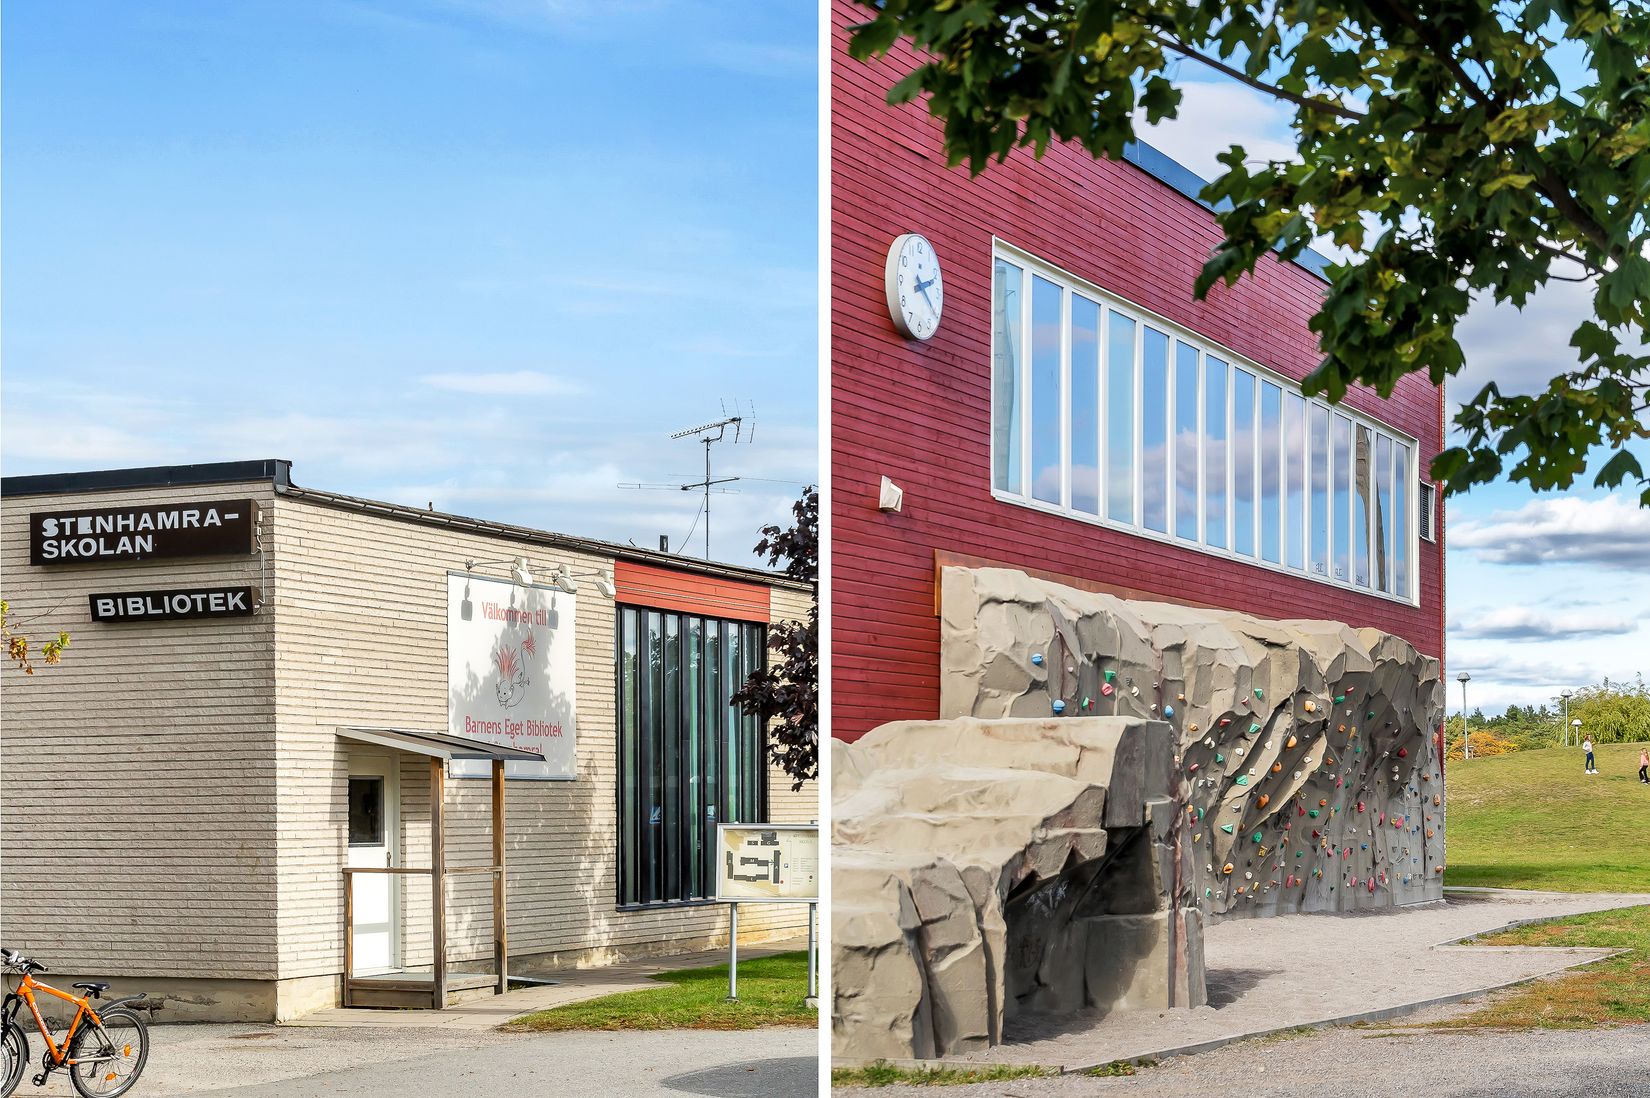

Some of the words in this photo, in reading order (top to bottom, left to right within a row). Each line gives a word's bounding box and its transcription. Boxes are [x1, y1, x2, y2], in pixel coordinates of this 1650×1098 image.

[41, 534, 153, 559] SKOLAN
[96, 591, 247, 617] BIBLIOTEK
[481, 601, 533, 625] Välkommen
[535, 608, 547, 626] till
[465, 715, 502, 735] Barnens
[504, 718, 524, 740] Eget
[526, 719, 563, 738] Bibliotek
